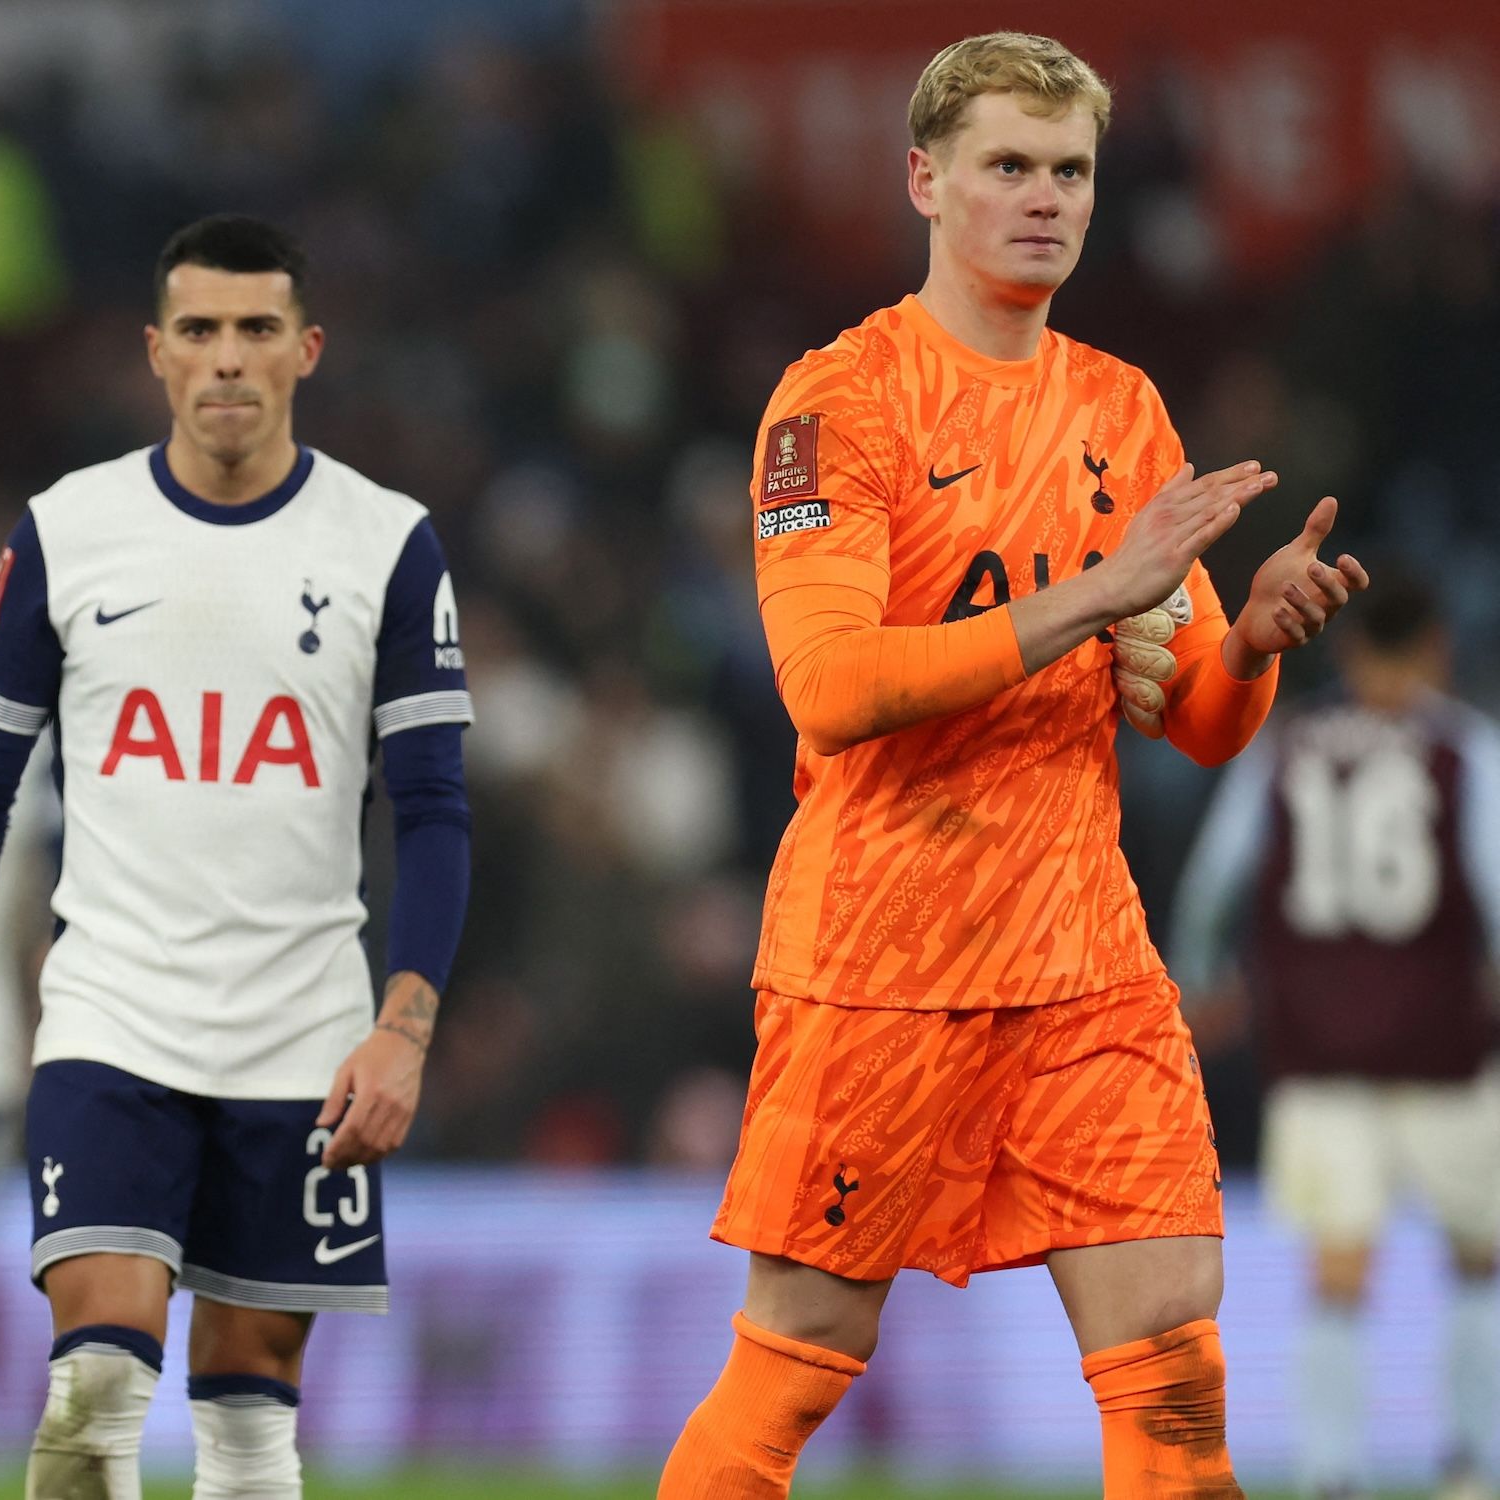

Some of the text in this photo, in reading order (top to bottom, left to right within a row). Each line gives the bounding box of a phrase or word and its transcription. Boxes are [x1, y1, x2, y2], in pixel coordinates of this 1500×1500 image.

[767, 475, 808, 493] FA CUP
[768, 465, 808, 481] Emirates
[757, 502, 822, 527] No room
[757, 514, 831, 540] for racism
[99, 686, 321, 787] AIA
